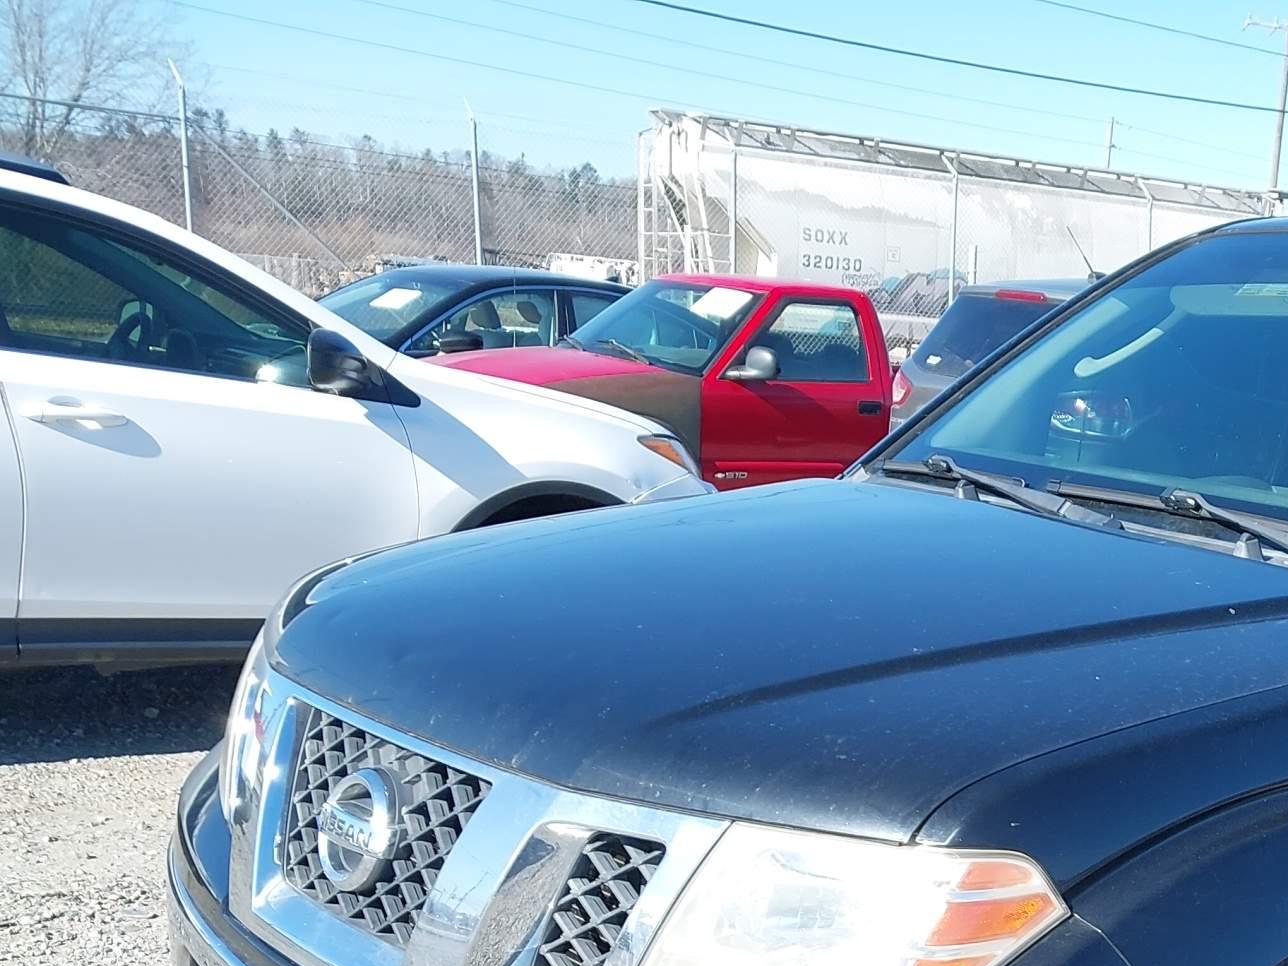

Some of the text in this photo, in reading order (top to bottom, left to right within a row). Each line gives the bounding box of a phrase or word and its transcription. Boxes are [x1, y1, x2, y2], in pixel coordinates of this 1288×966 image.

[802, 228, 849, 246] SOXX
[802, 254, 862, 273] 320130
[319, 807, 373, 851] NISSAN
